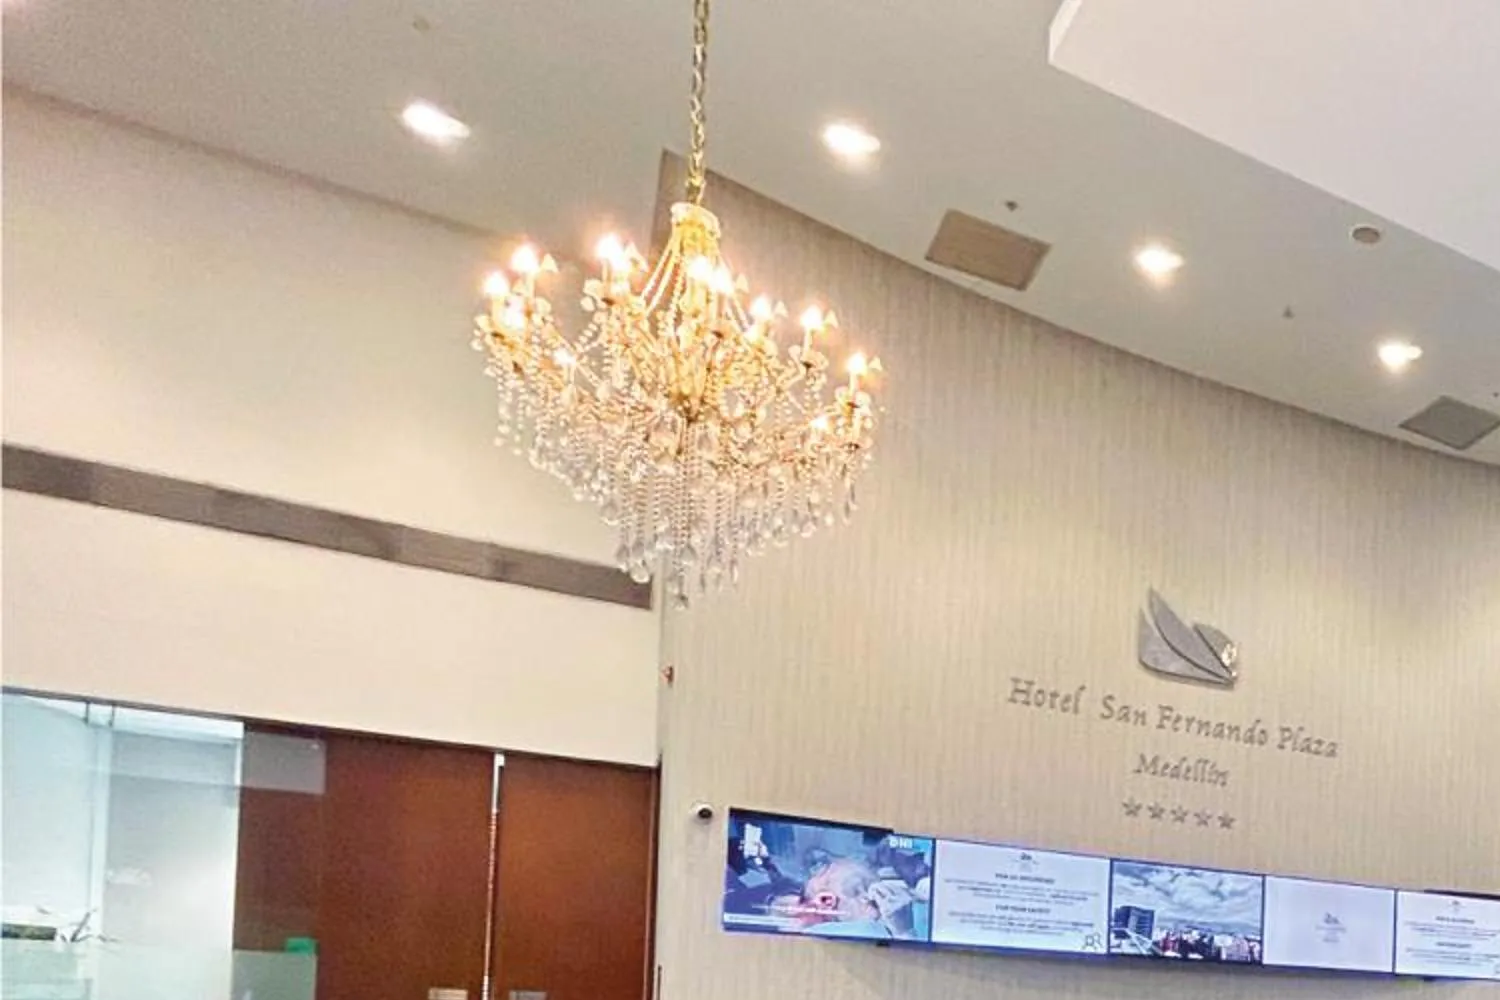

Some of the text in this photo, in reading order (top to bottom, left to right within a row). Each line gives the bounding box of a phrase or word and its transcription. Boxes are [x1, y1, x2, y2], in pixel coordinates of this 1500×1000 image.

[1007, 677, 1339, 758] Hotel San Fernando Plaza
[1132, 752, 1229, 788] Medellín
